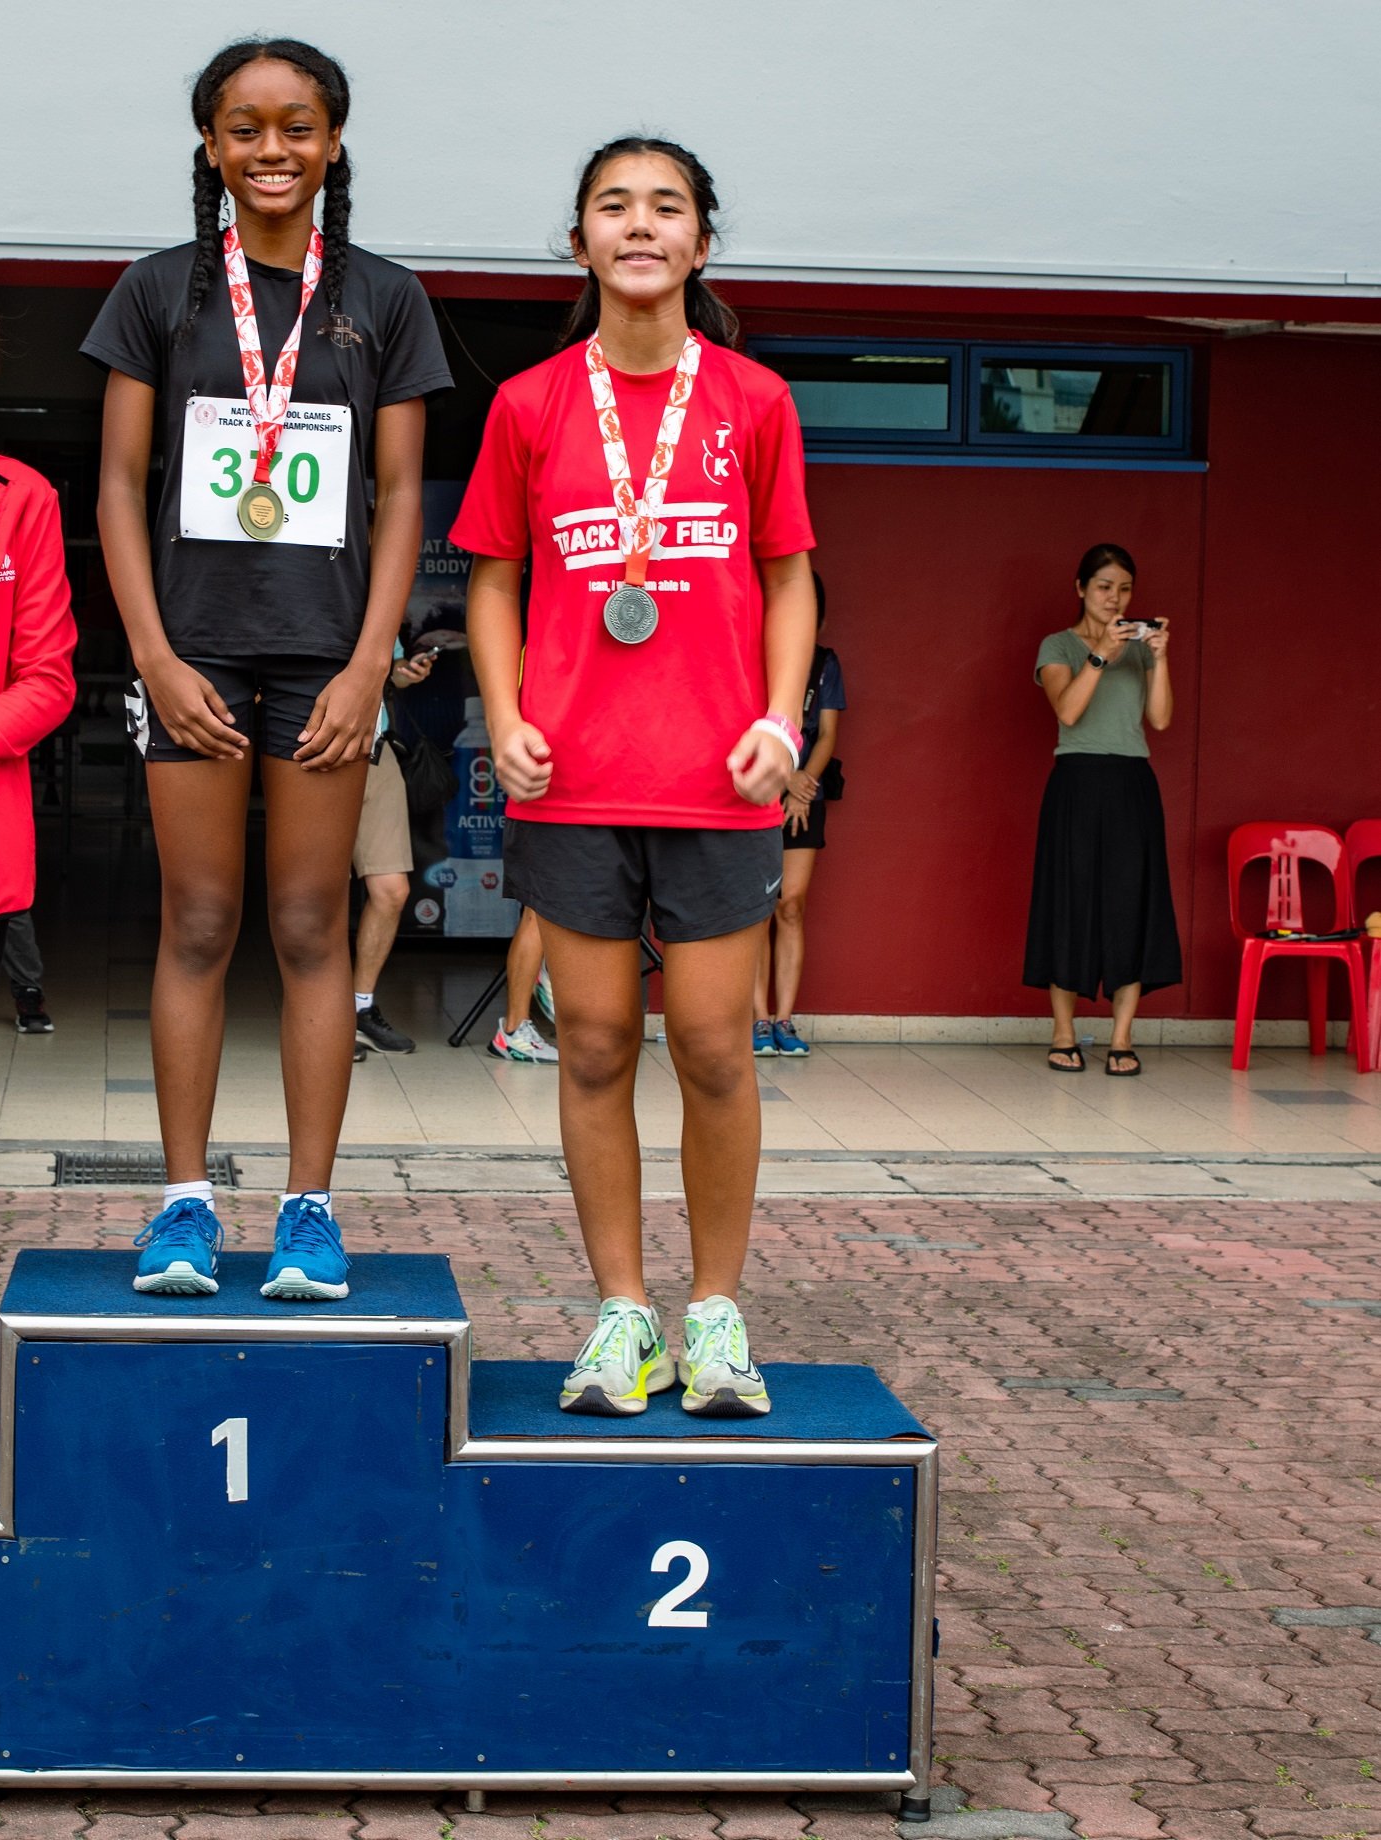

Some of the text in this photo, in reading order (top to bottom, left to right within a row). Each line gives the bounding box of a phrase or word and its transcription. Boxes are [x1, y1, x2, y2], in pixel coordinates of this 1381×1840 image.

[231, 407, 332, 421] NATIO OOL GAMES
[219, 418, 343, 433] TRACK & HAMPIONSHIPS
[552, 519, 738, 556] TRACK FIELD
[425, 559, 470, 574] BODY
[658, 580, 678, 591] able
[679, 580, 691, 591] to
[458, 815, 507, 829] ACTIVE
[212, 1418, 248, 1502] 1
[648, 1540, 709, 1628] 2
